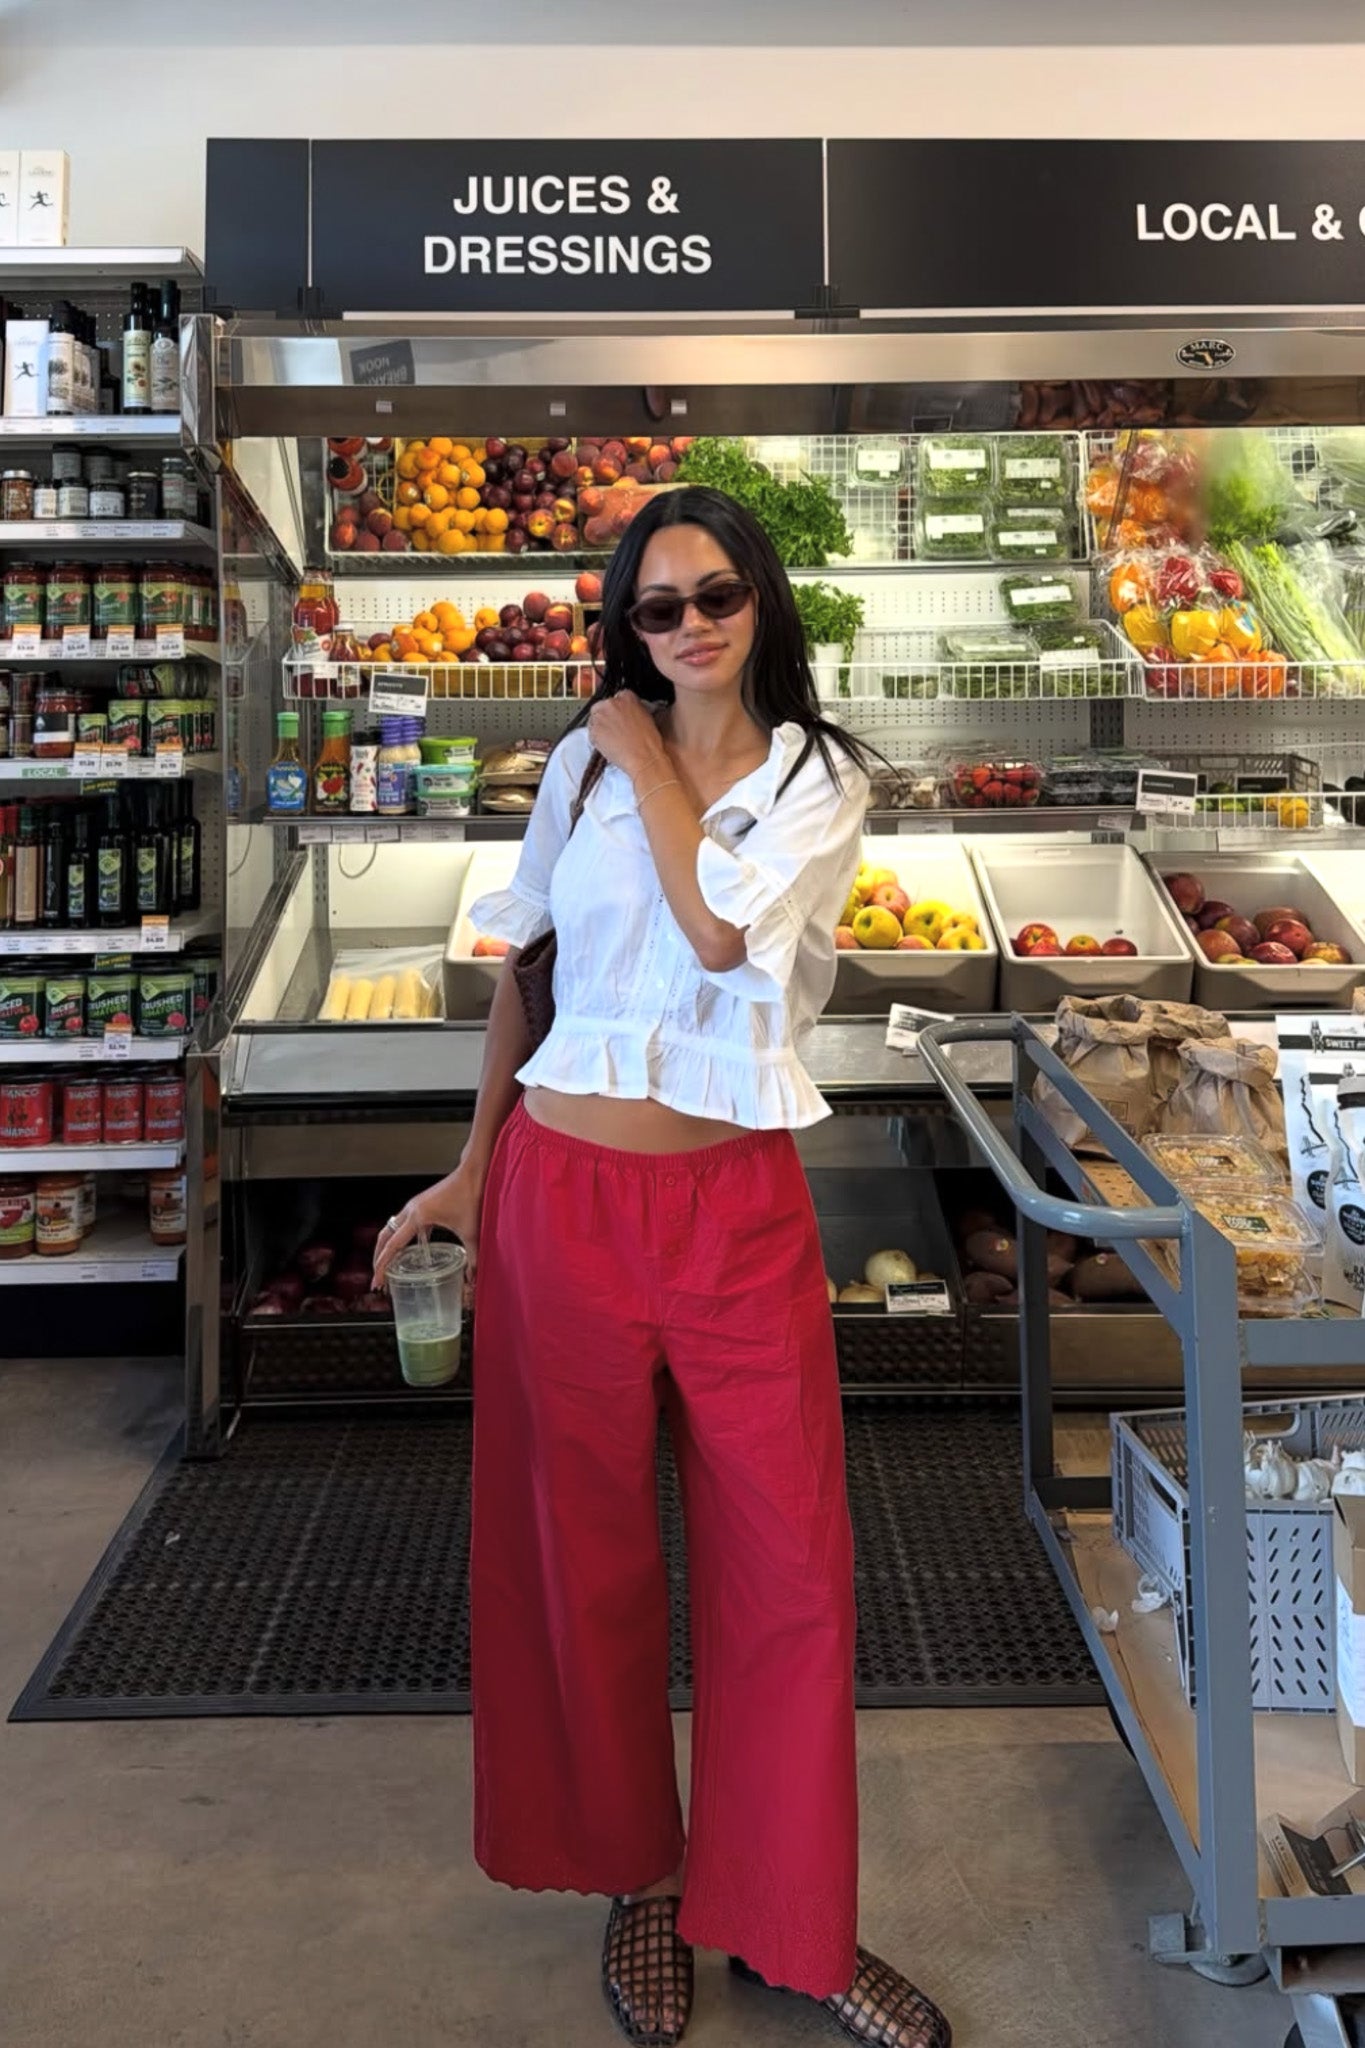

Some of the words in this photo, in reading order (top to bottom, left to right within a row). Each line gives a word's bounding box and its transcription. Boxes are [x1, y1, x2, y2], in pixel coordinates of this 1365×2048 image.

[453, 175, 631, 215] JUICES
[647, 176, 680, 214] &
[1136, 202, 1297, 241] LOCAL
[1312, 203, 1345, 241] &
[424, 234, 712, 275] DRESSINGS
[28, 767, 59, 777] LOCAL
[141, 994, 184, 1009] CRUSHED
[1325, 1038, 1354, 1049] SWEET
